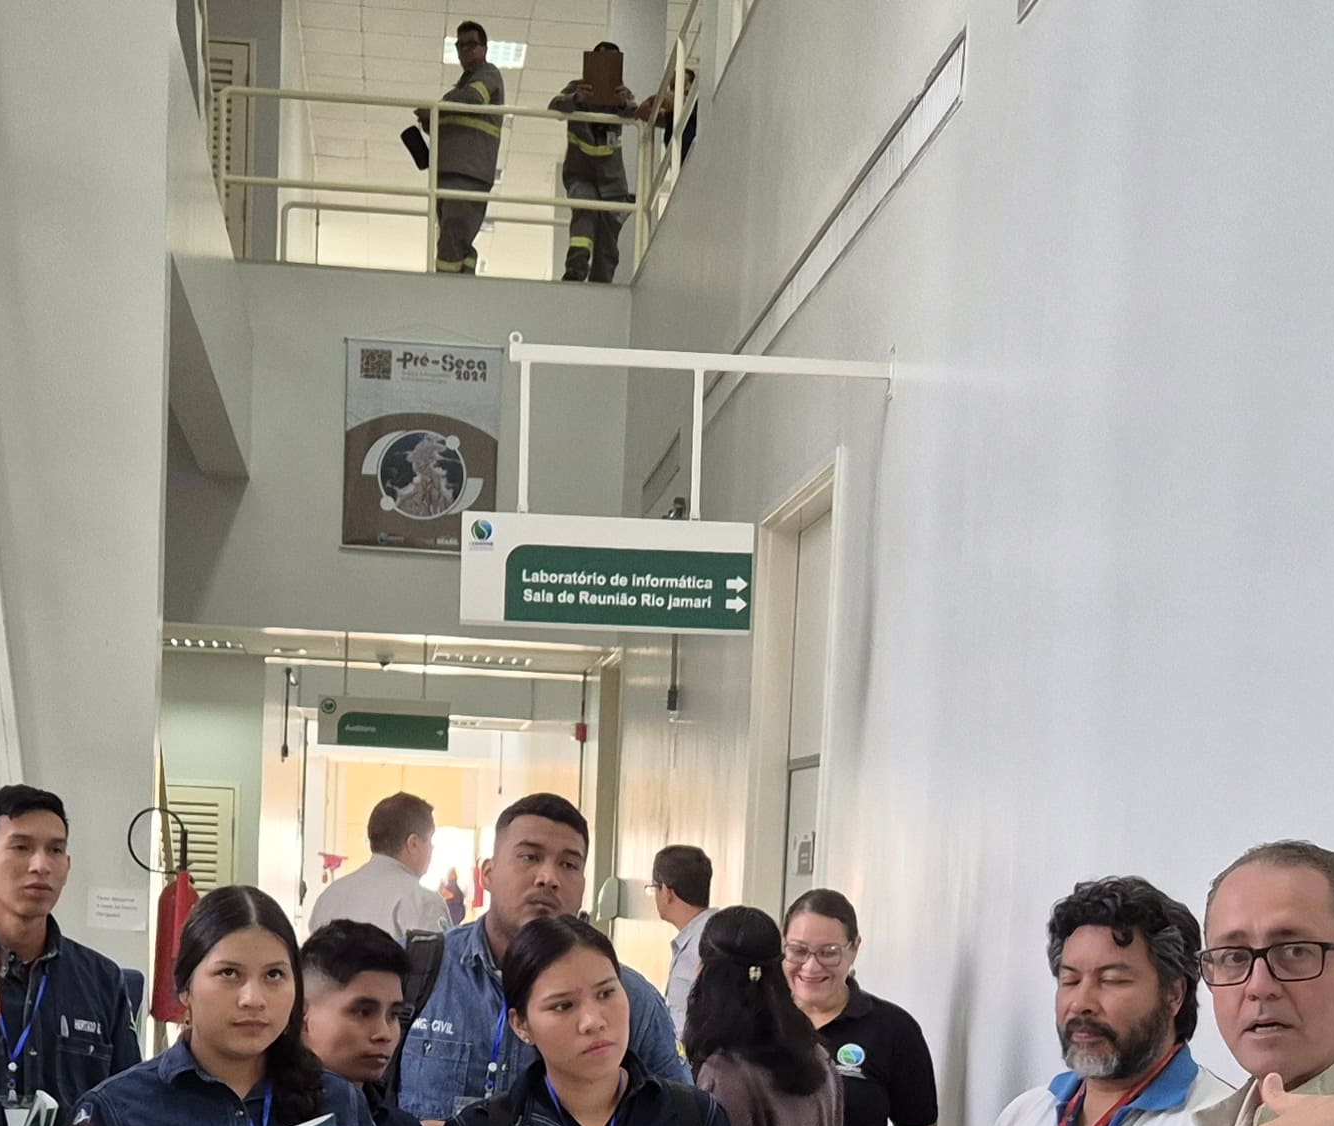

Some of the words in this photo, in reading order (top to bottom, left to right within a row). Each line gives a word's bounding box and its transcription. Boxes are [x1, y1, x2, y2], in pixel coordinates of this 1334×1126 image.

[522, 568, 607, 586] Laboratório
[610, 573, 628, 587] de
[523, 588, 554, 603] Sala
[557, 590, 575, 604] de
[579, 591, 637, 607] Reunião
[641, 593, 665, 608] Rio
[431, 1020, 454, 1035] CIVIL
